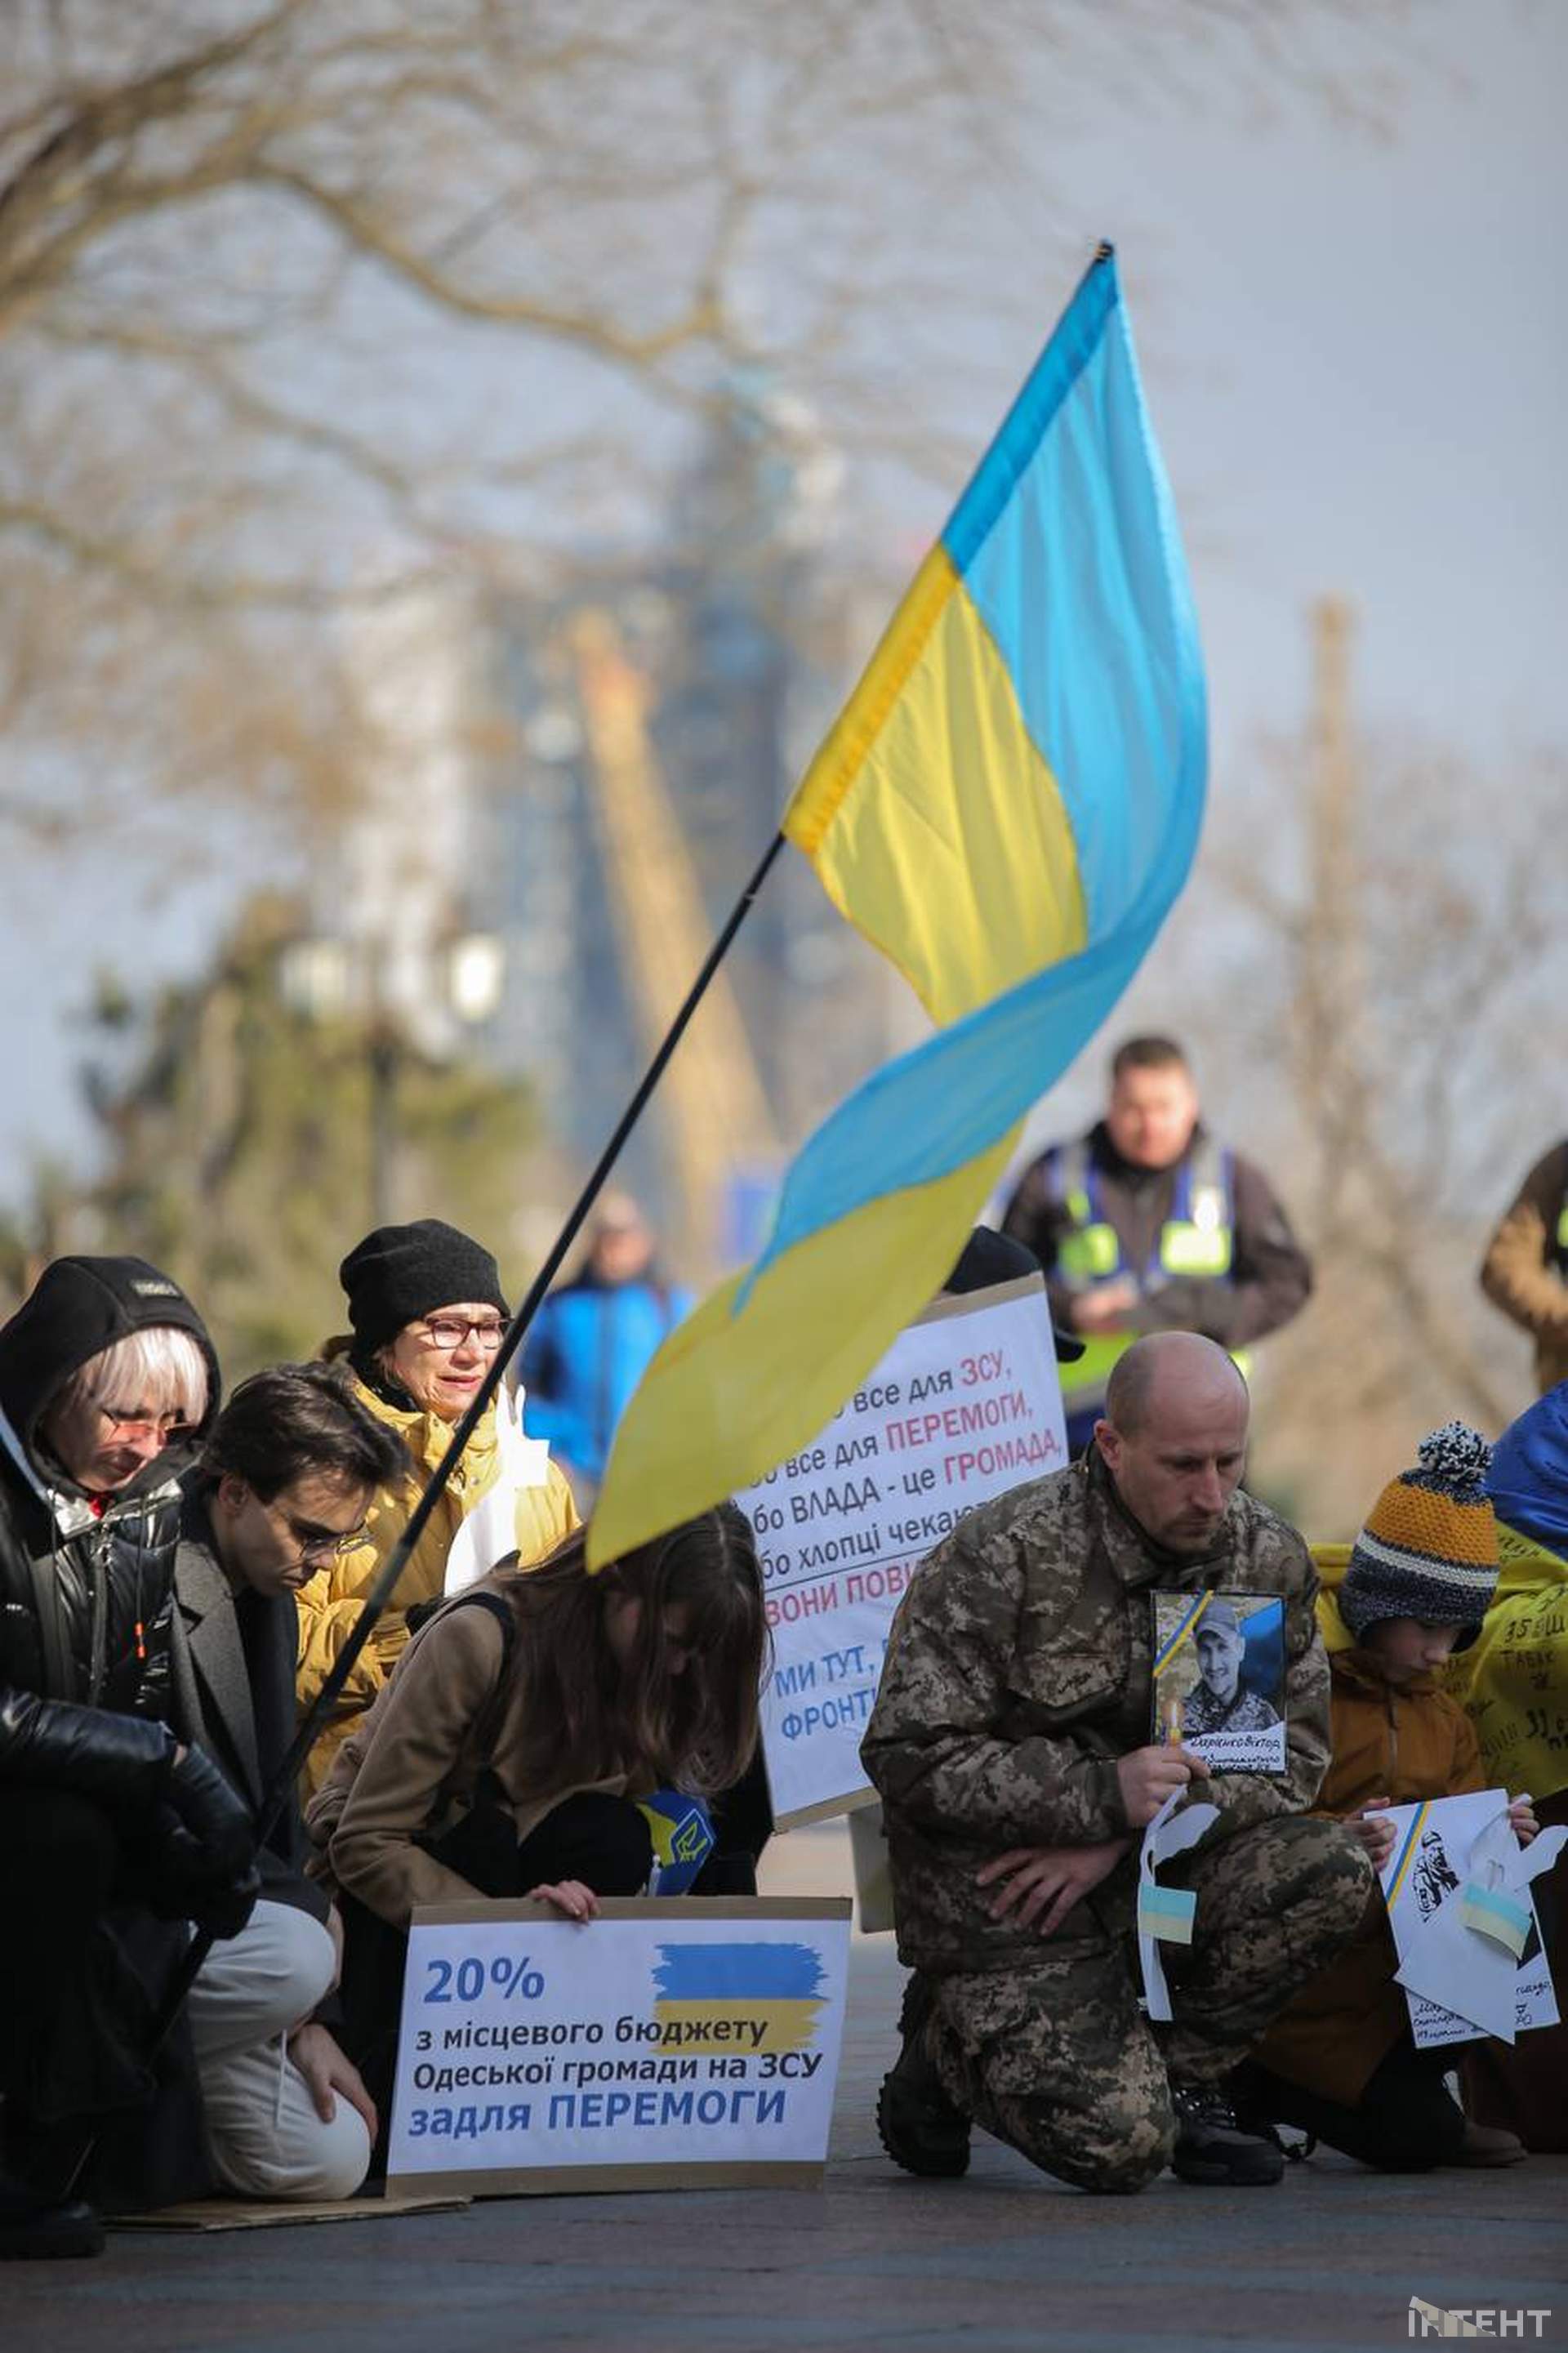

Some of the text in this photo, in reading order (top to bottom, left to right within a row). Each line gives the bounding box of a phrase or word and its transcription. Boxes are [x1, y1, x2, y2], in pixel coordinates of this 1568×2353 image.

[853, 1384, 899, 1412] все
[909, 1370, 953, 1403] для
[960, 1349, 1011, 1385] ЗСУ,
[786, 1449, 826, 1477] все
[835, 1436, 878, 1469] для
[886, 1391, 1032, 1451] ПЕРЕМОГИ,
[791, 1477, 880, 1524] ВЛАДА
[903, 1468, 935, 1495] це
[944, 1428, 1062, 1485] ГРОМАДА,
[799, 1523, 880, 1570] хлопці
[889, 1502, 987, 1544] чека
[764, 1582, 838, 1627] ВОНИ
[775, 1661, 815, 1698] МИ
[822, 1646, 875, 1682] ТУТ,
[422, 1957, 545, 2003] 20%
[416, 2016, 768, 2051] з місцевого бюджету
[413, 2052, 823, 2092] Одеської громади на ЗСУ
[409, 2090, 786, 2140] задля ПЕРЕМОГИ
